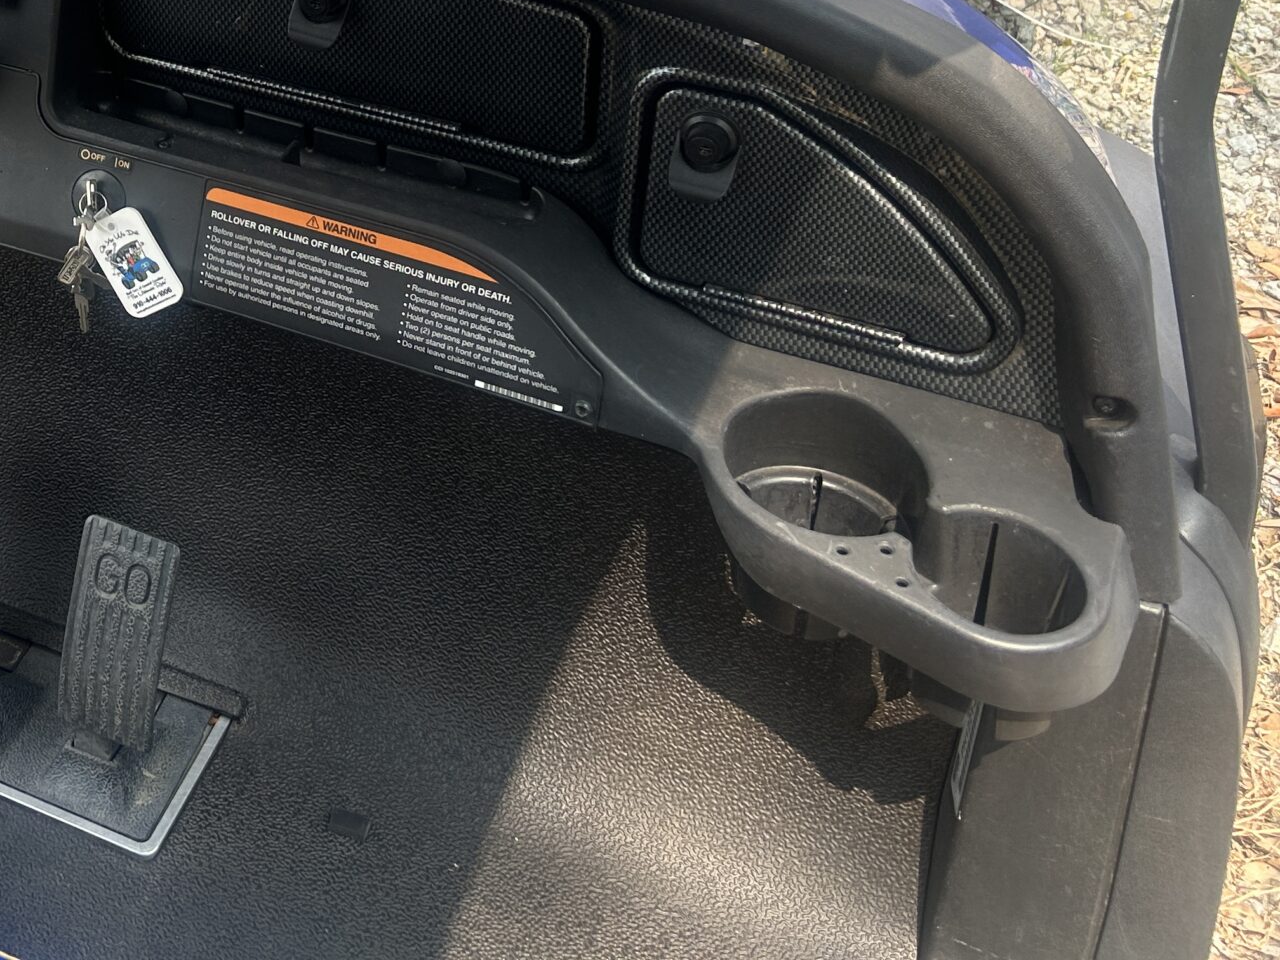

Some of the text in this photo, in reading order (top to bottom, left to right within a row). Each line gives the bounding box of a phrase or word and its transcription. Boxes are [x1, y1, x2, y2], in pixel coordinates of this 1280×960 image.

[91, 152, 130, 169] OFF ON
[212, 225, 233, 237] Before
[234, 232, 252, 244] using
[279, 245, 294, 255] read
[295, 250, 326, 266] operating
[322, 220, 377, 245] WARNING
[208, 244, 226, 256] Keep
[227, 249, 245, 260] entire
[246, 255, 263, 267] body
[263, 260, 283, 271] inside
[284, 266, 308, 279] vehicle
[308, 273, 326, 284] while
[210, 209, 512, 304] ROLLOVER OR FALLING OFF MAY CAUSE SERIOUS INJURY OR DEATH.
[221, 238, 232, 246] not
[233, 241, 248, 251] start
[249, 246, 271, 258] vehicle
[272, 253, 287, 263] until
[288, 257, 296, 265] all
[296, 260, 331, 277] occupants
[332, 272, 344, 280] are
[204, 271, 223, 282] Never
[224, 277, 249, 292] operate
[250, 285, 269, 296] under
[270, 291, 281, 300] the
[282, 295, 312, 309] influence
[321, 306, 346, 319] alcohol
[206, 262, 219, 272] Use
[220, 266, 242, 278] brakes
[250, 275, 273, 288] reduce
[274, 283, 295, 296] speed
[296, 289, 314, 300] when
[315, 295, 344, 311] coasting
[207, 253, 224, 263] Drive
[225, 258, 245, 271] slowly
[253, 267, 271, 277] turns
[271, 272, 285, 282] and
[285, 276, 310, 291] straight
[321, 287, 335, 297] and
[336, 291, 354, 303] down
[411, 283, 439, 298] Remain
[440, 292, 465, 305] seated
[466, 299, 485, 311] while
[203, 280, 214, 289] For
[215, 285, 227, 293] use
[237, 290, 271, 306] authorized
[271, 302, 298, 316] persons
[306, 311, 343, 329] designated
[344, 324, 364, 334] areas
[408, 302, 429, 314] Never
[430, 309, 458, 324] operate
[470, 321, 492, 334] public
[409, 293, 438, 309] Operate
[439, 302, 457, 313] from
[457, 307, 478, 319] driver
[480, 314, 495, 324] side
[404, 321, 419, 331] Two
[419, 325, 430, 336] (2)
[431, 330, 460, 345] persons
[461, 339, 473, 349] per
[475, 342, 491, 353] seat
[406, 312, 423, 322] Hold
[443, 323, 460, 333] seat
[461, 328, 486, 341] handle
[487, 336, 506, 347] while
[402, 330, 424, 343] Never
[425, 337, 445, 349] stand
[454, 346, 471, 357] front
[491, 357, 516, 370] behind
[413, 343, 425, 352] not
[426, 347, 445, 358] leave
[446, 353, 478, 368] children
[479, 363, 518, 380] unattended
[95, 553, 152, 606] GO
